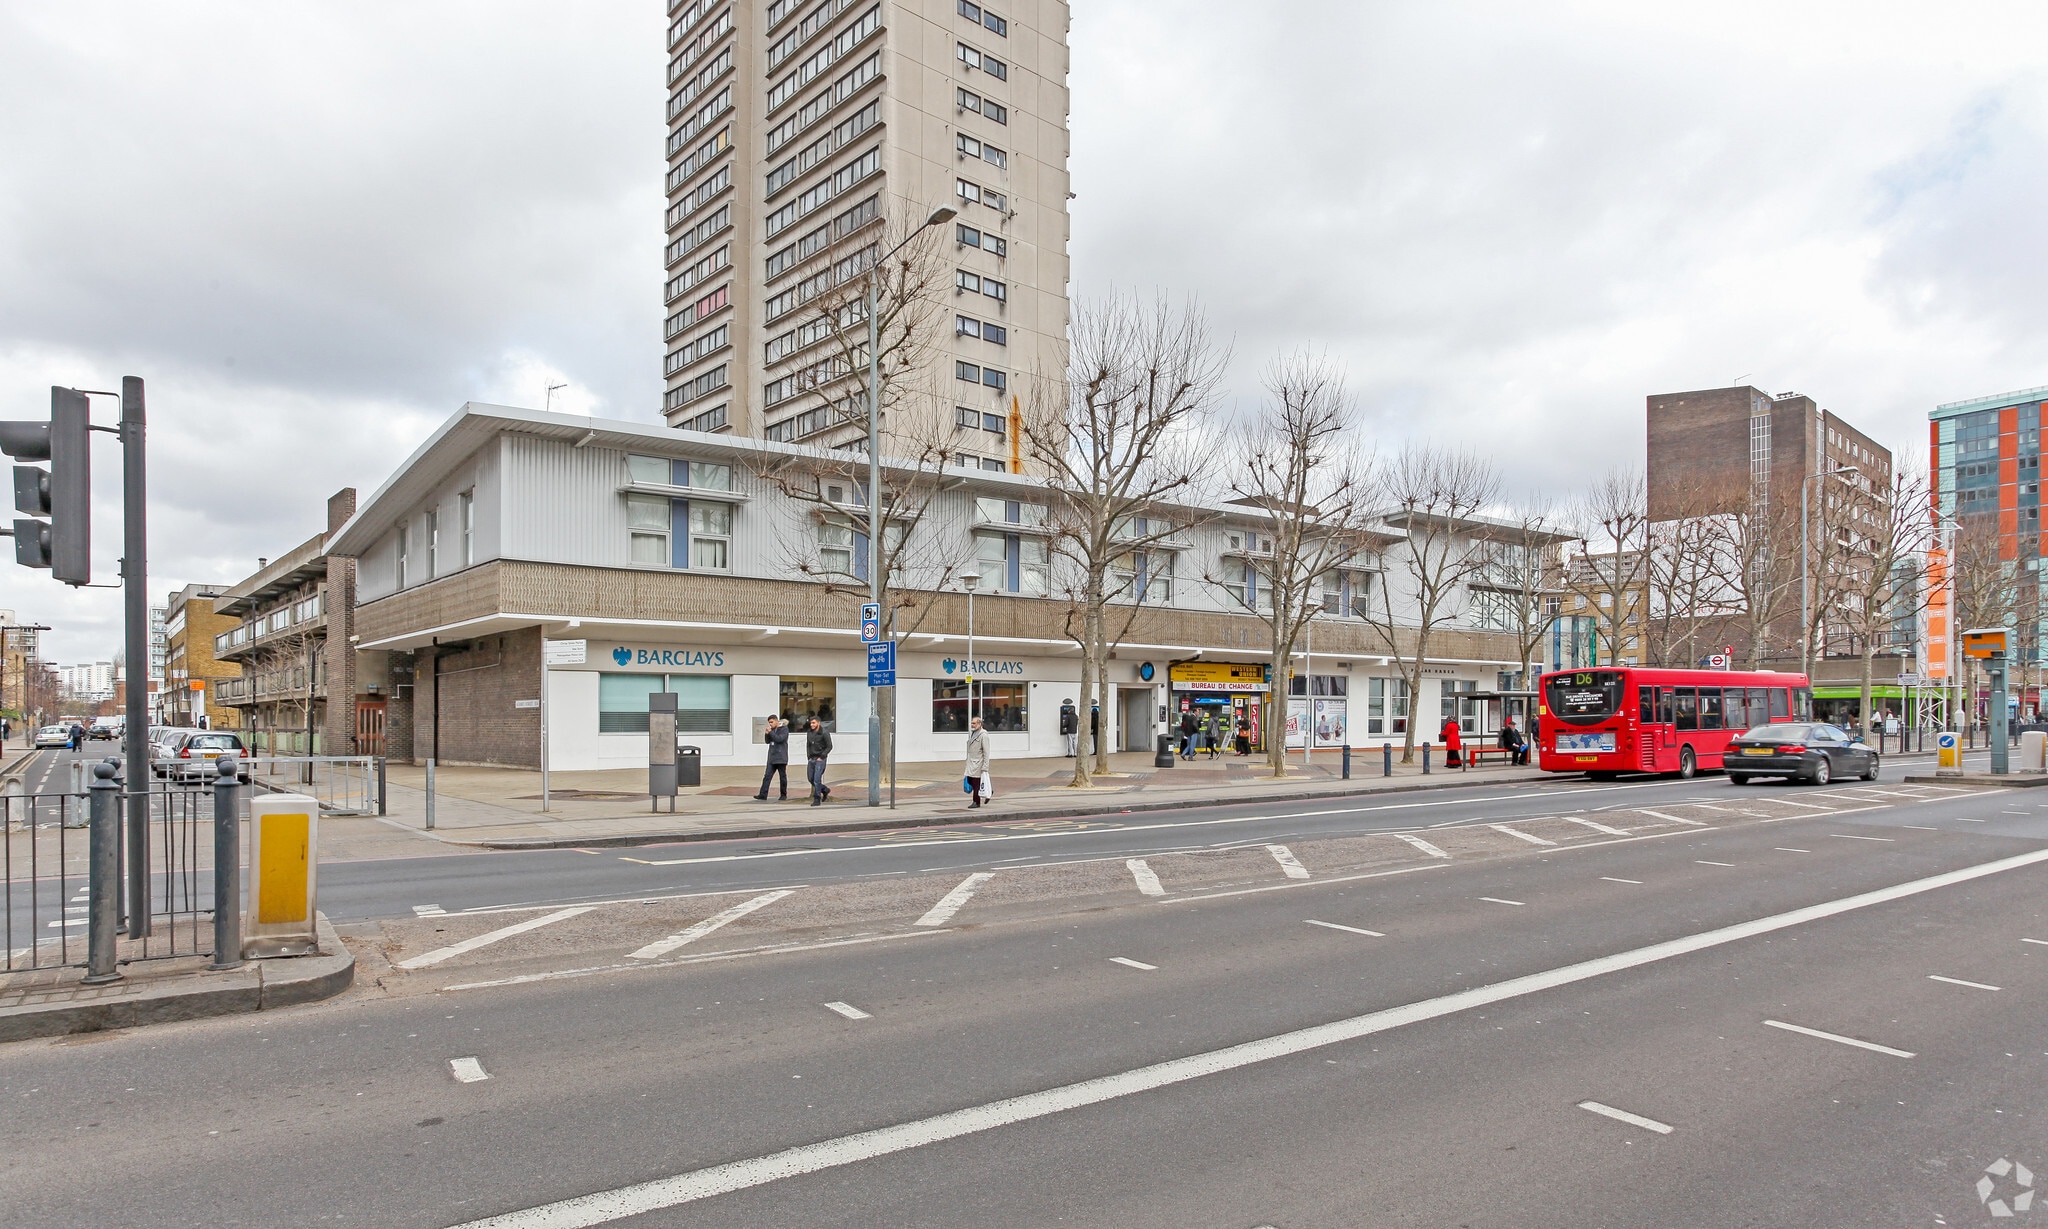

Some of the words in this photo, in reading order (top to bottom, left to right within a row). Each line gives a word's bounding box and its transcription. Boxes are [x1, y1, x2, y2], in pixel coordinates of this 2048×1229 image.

[865, 627, 875, 635] 30
[637, 649, 724, 667] BARCLAYS
[960, 660, 1023, 675] BARCLAYS
[1576, 673, 1593, 685] D6
